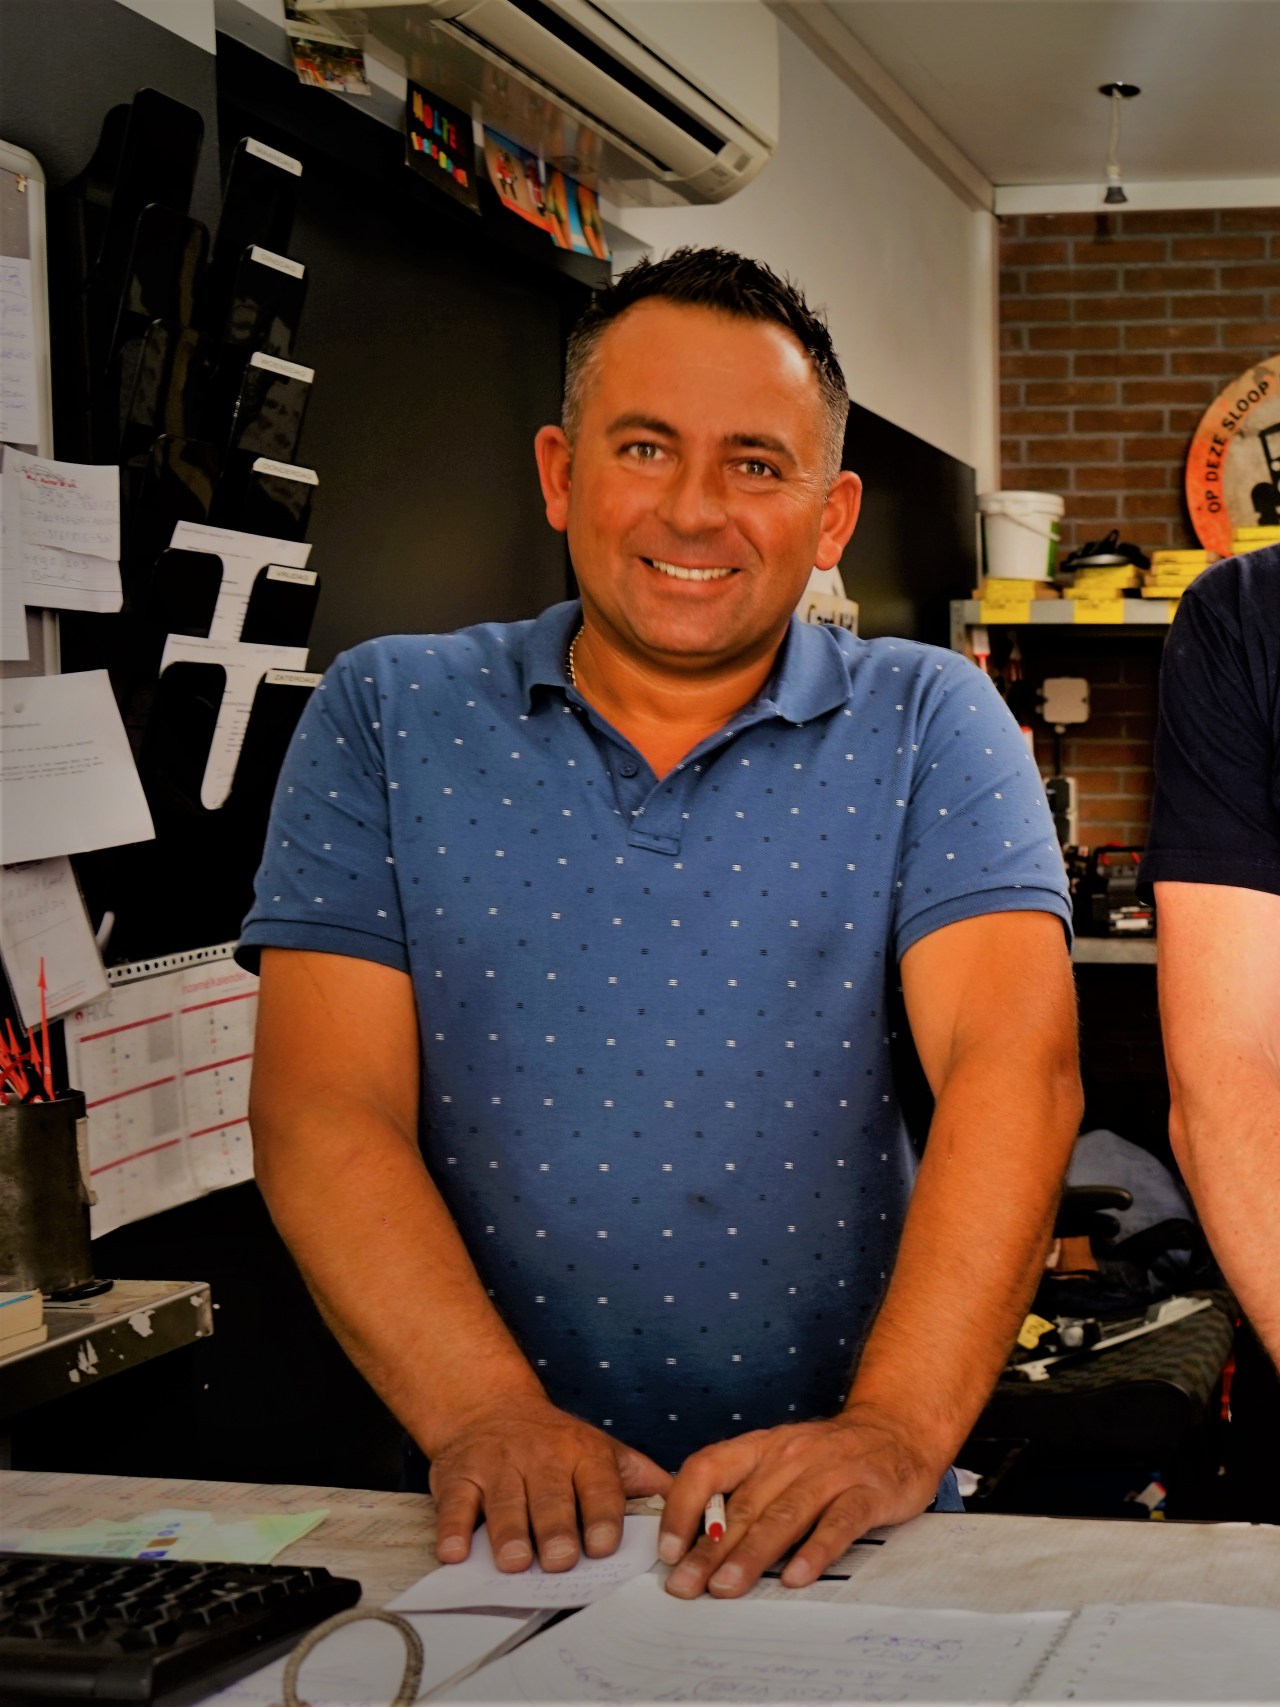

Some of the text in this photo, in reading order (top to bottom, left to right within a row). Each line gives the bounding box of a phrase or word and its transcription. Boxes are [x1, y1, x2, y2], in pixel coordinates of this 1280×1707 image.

[1221, 379, 1271, 432] SLOOP
[1205, 433, 1228, 483] DEZE
[1205, 489, 1222, 514] OP
